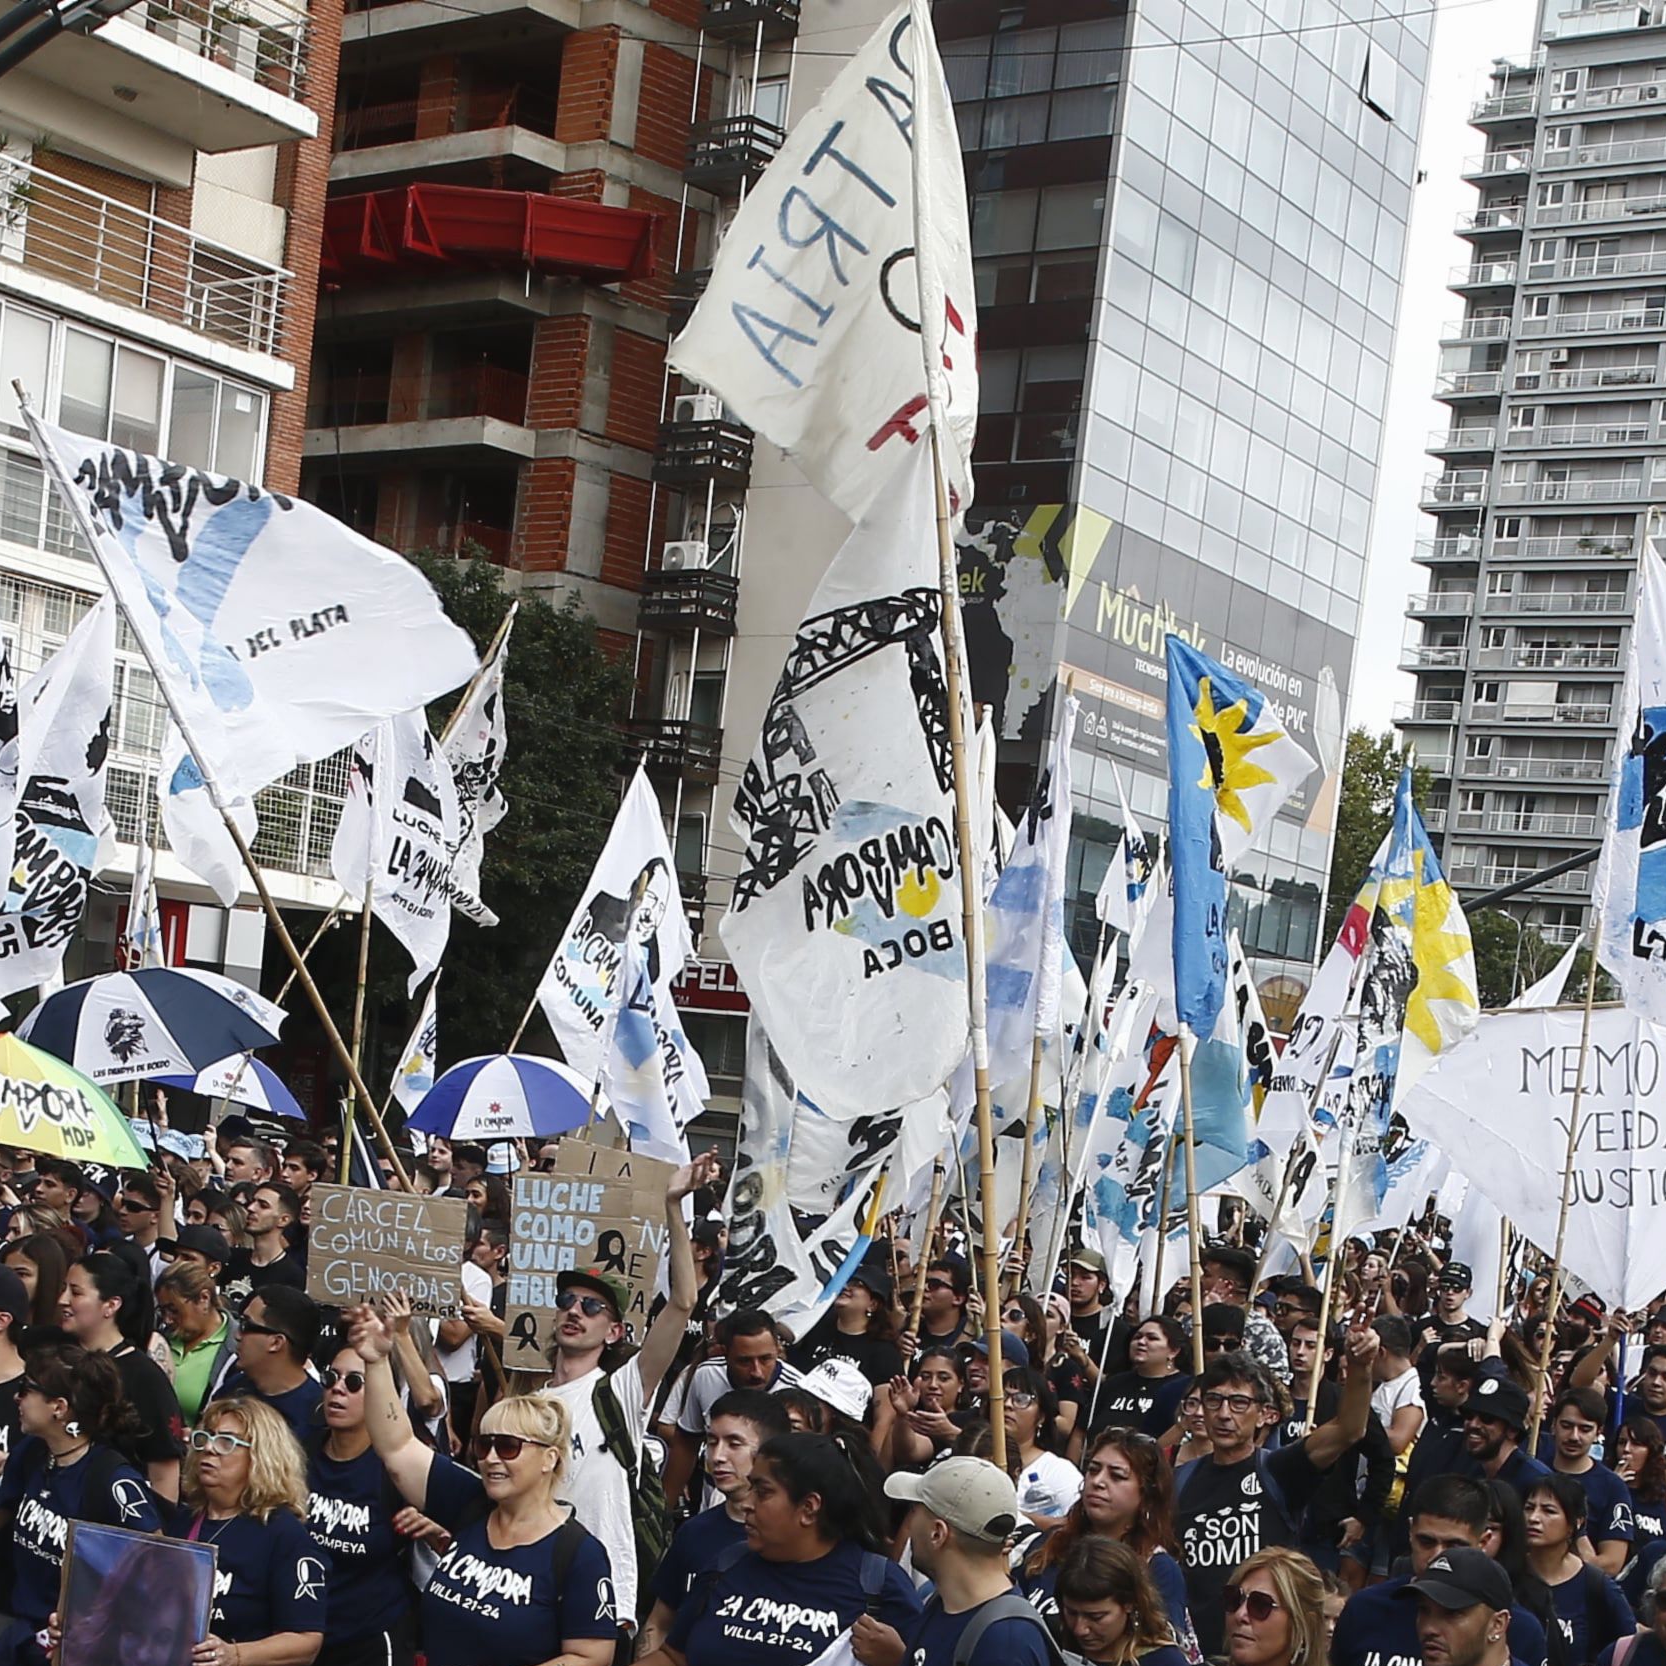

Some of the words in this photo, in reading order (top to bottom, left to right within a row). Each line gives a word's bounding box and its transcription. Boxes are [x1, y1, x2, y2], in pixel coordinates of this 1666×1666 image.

[246, 627, 281, 658] DEL
[289, 603, 349, 642] PLATA
[1220, 641, 1233, 669] La
[1235, 653, 1287, 693] evolución
[1287, 677, 1303, 699] en
[1285, 704, 1308, 734] PVC
[553, 955, 605, 1034] COMUNA
[62, 1125, 95, 1150] MDP
[322, 1187, 432, 1234] CÁRCEL
[516, 1178, 605, 1214] LUCHE
[311, 1225, 399, 1254] COMÚN
[405, 1233, 418, 1256] A
[423, 1240, 460, 1264] LOS
[514, 1216, 596, 1246] COMO
[512, 1247, 576, 1272] UNA
[1205, 1512, 1261, 1541] SON
[430, 1580, 461, 1606] VILLA
[461, 1596, 501, 1620] 21-24
[449, 1554, 531, 1607] CAMPORA
[716, 1594, 738, 1618] LA
[742, 1597, 840, 1639] CAMPORA
[723, 1624, 765, 1645] VILLA
[767, 1633, 814, 1655] 21-24
